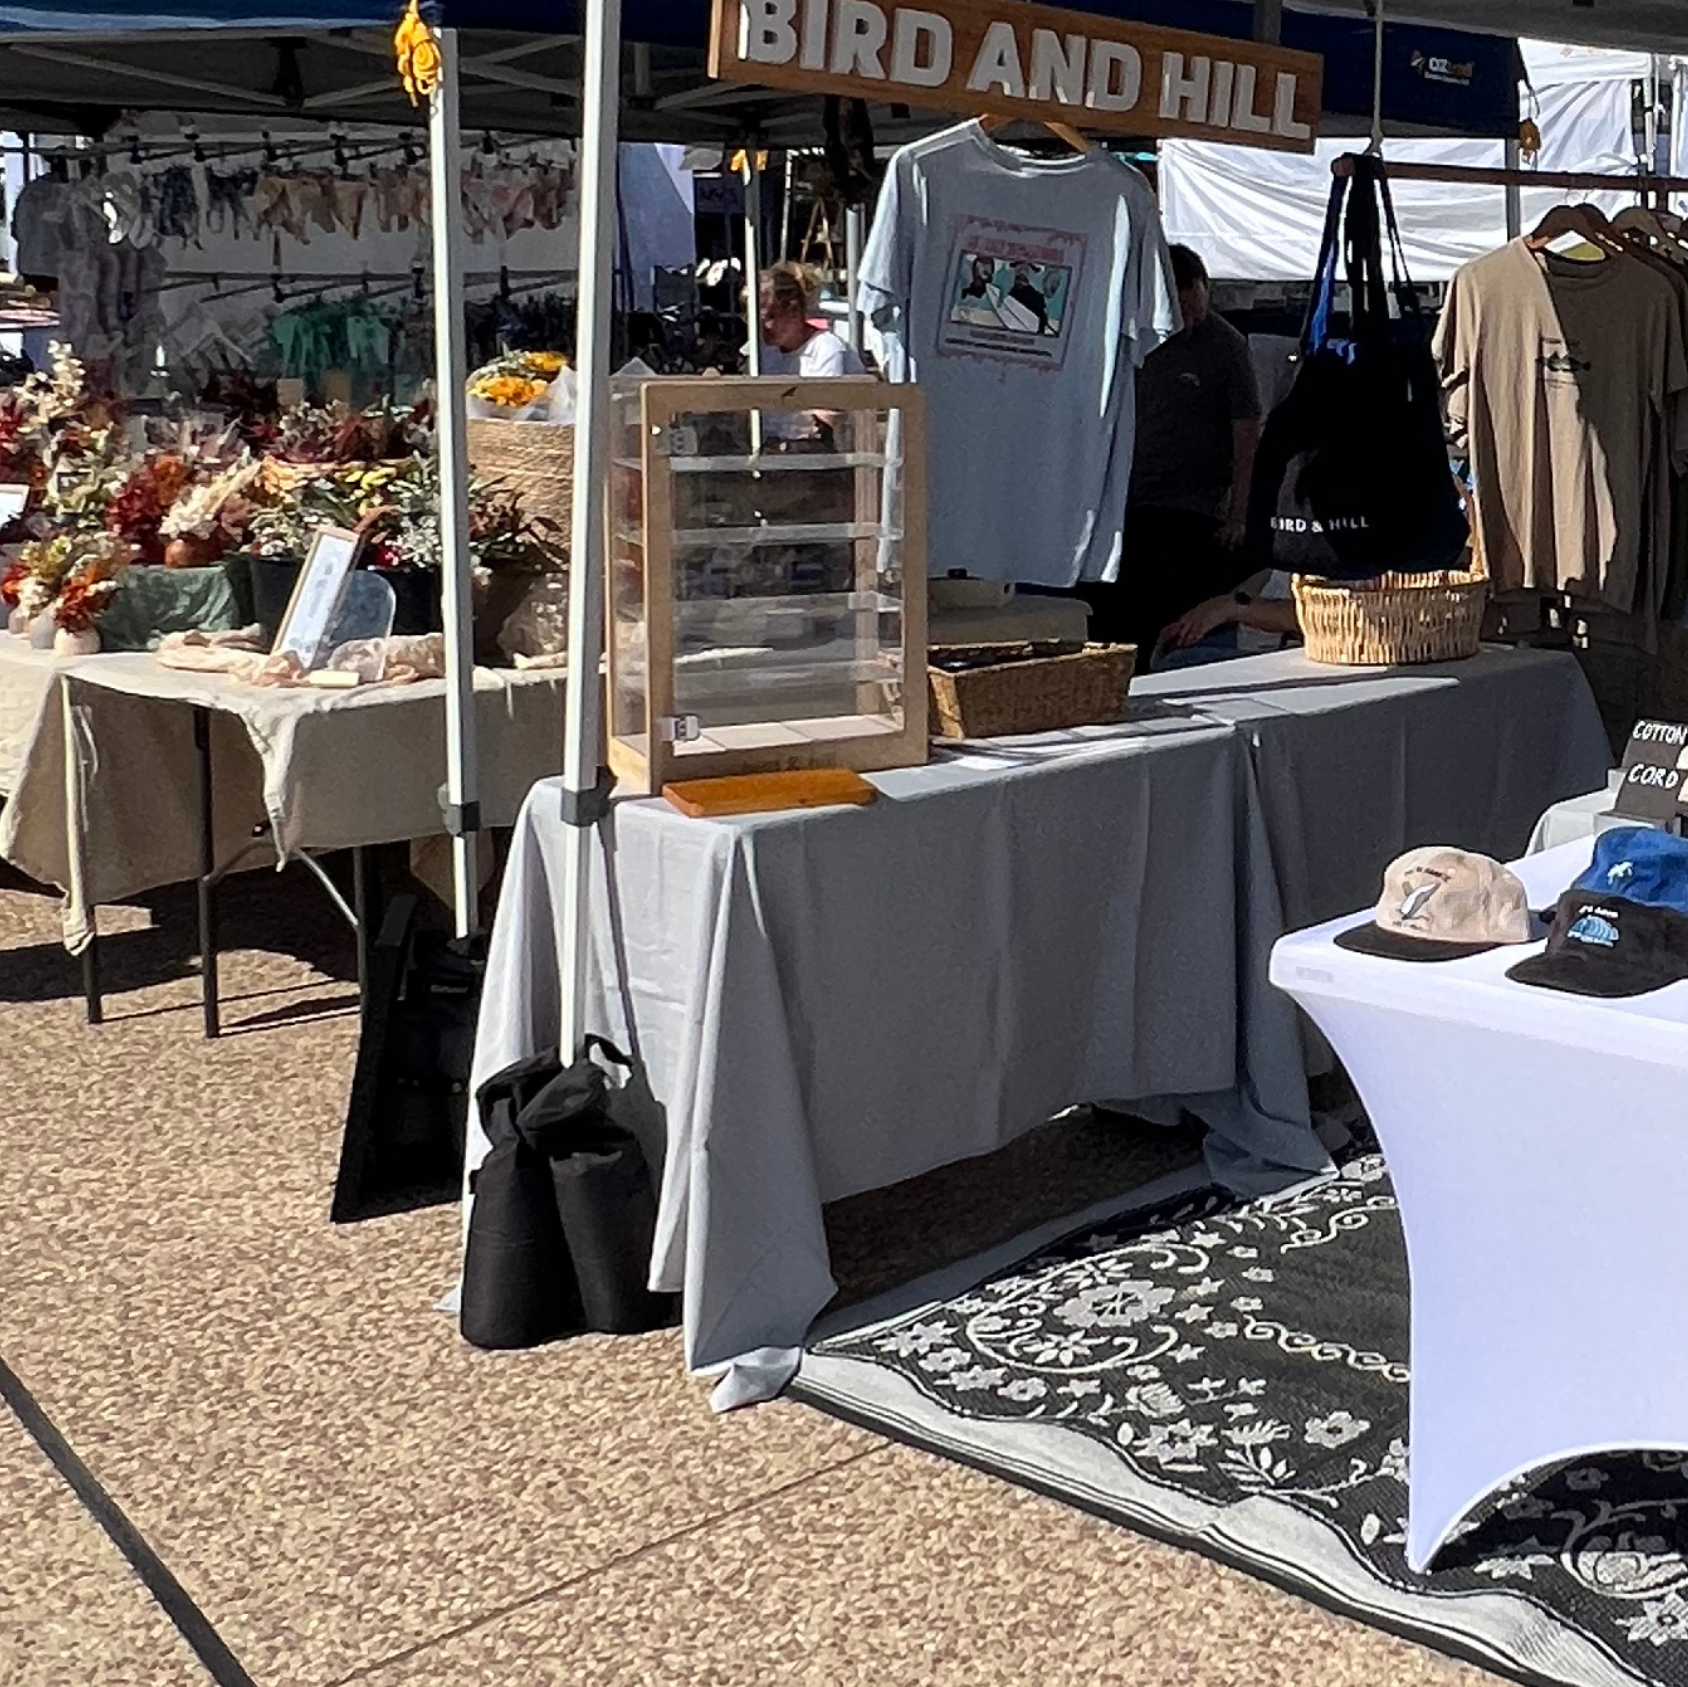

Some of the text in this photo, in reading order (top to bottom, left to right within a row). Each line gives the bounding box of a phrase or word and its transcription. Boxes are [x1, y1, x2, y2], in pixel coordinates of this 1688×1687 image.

[966, 21, 1143, 112] AND
[1158, 50, 1311, 140] HILL
[1270, 515, 1369, 533] BIRD & HILL
[1632, 720, 1688, 745] COTTON
[1627, 763, 1679, 789] CORD
